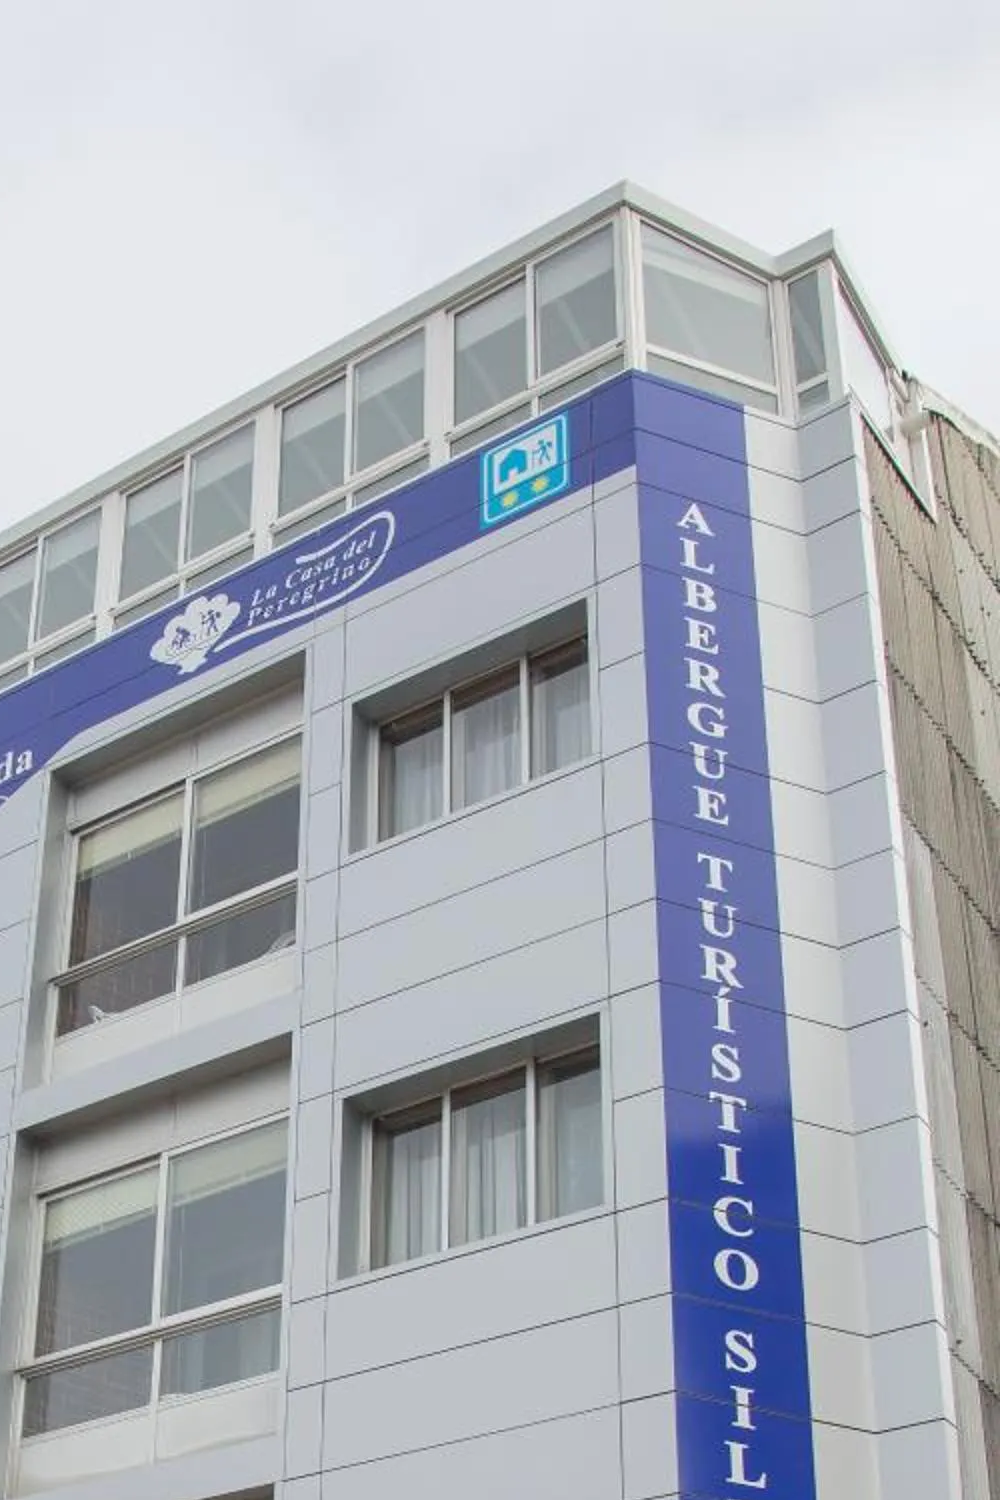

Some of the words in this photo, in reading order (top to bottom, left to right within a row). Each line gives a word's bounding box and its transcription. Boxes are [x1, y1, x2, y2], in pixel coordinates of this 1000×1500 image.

[247, 559, 373, 627] Peregrino
[250, 584, 277, 607] La
[285, 556, 337, 589] Casa
[342, 530, 377, 560] del
[676, 502, 730, 826] ALBERGUE
[696, 852, 760, 1292] TURÍSTICO
